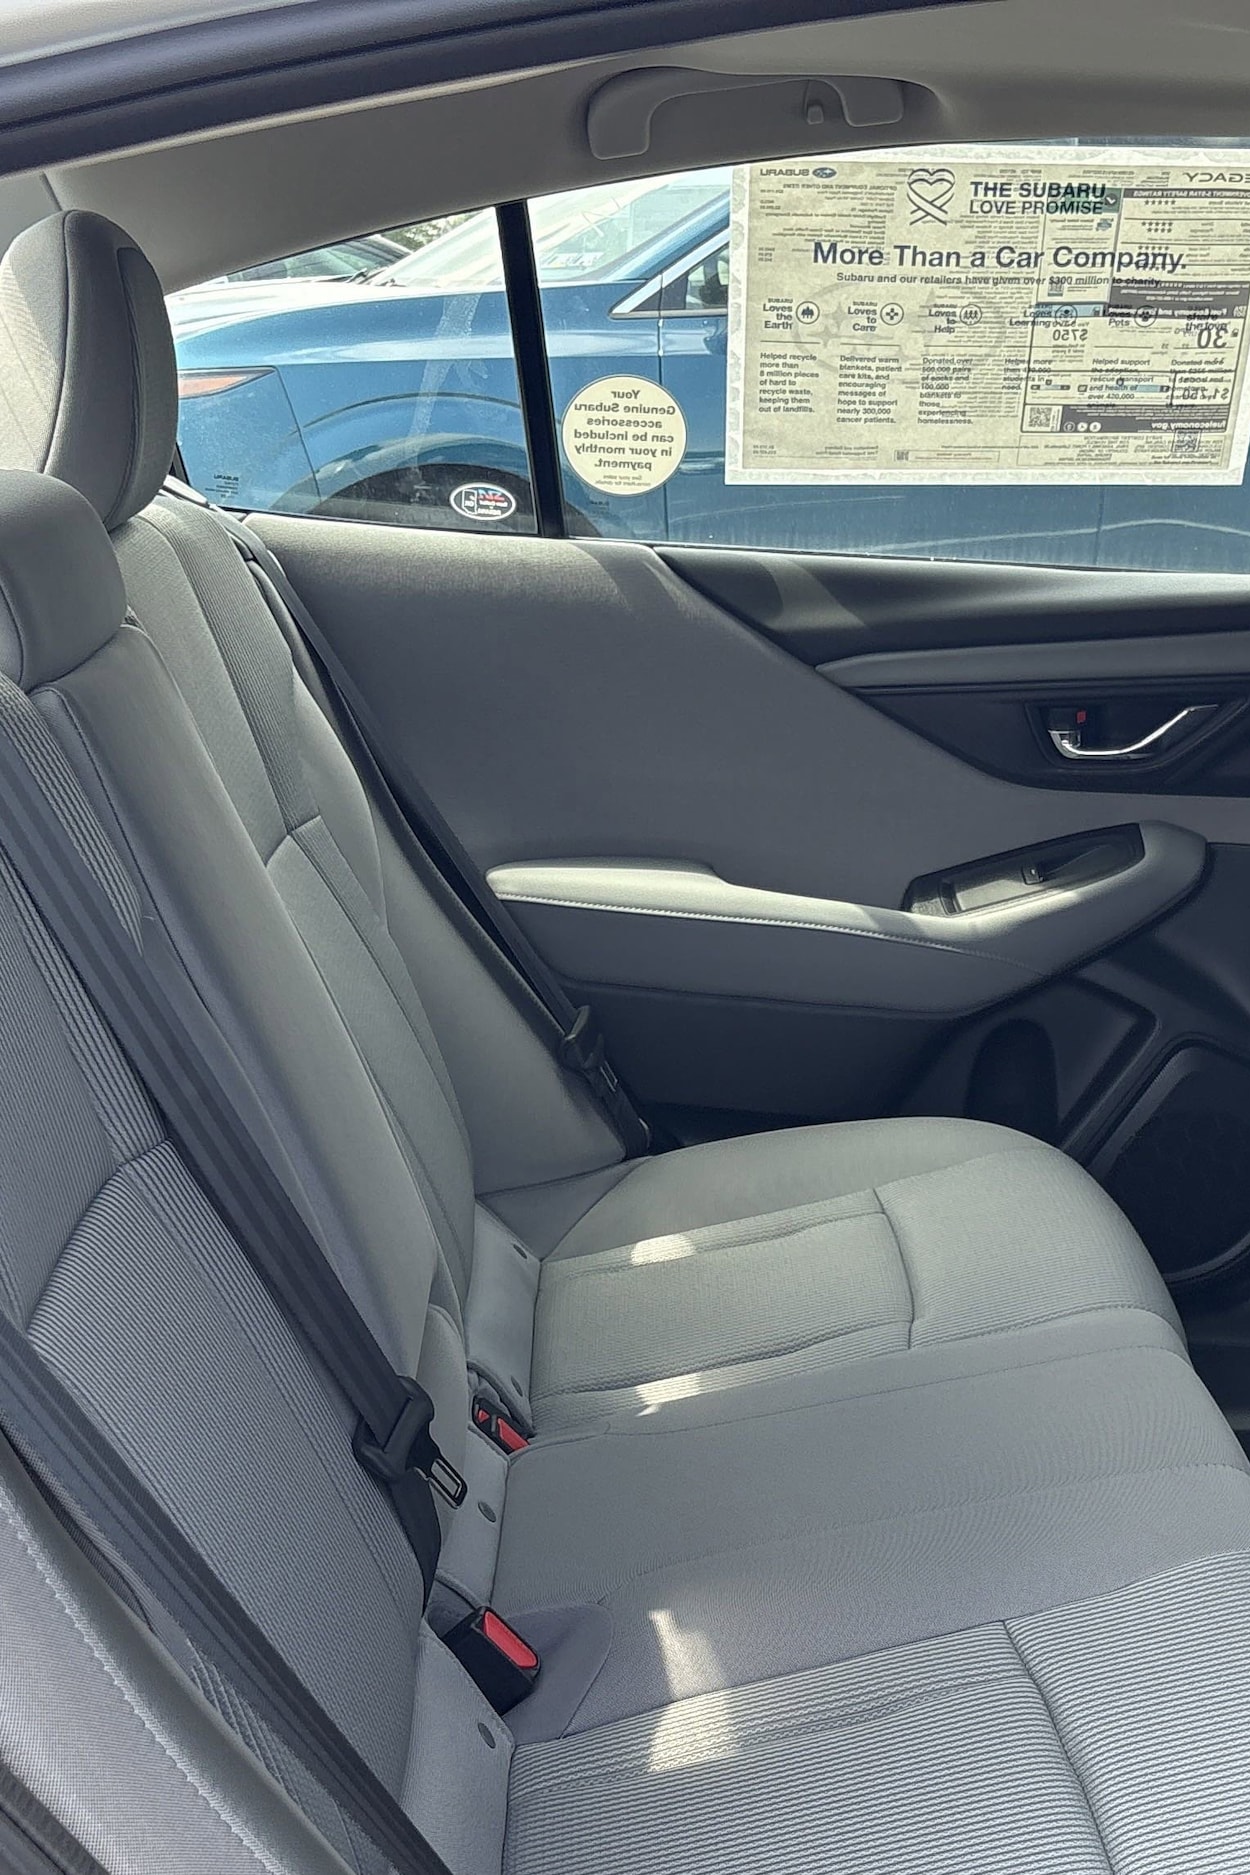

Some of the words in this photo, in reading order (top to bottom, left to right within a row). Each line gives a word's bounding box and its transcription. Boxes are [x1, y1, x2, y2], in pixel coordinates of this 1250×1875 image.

[970, 182, 1012, 198] THE
[1019, 182, 1106, 198] SUBARU
[969, 200, 1018, 214] LOVE
[1021, 201, 1103, 215] PROMISE
[813, 242, 883, 265] More
[893, 245, 961, 267] Than
[970, 252, 985, 268] a
[995, 246, 1044, 269] Car
[1053, 246, 1187, 274] Company.
[837, 272, 874, 282] Subaru
[877, 274, 897, 282] and
[921, 275, 962, 284] retailers
[965, 276, 990, 285] have
[993, 276, 1020, 286] given
[1023, 277, 1046, 285] over
[1049, 276, 1073, 286] $300
[1075, 276, 1109, 285] million
[1112, 277, 1124, 285] to
[763, 304, 793, 312] Loves
[848, 307, 877, 315] Loves
[776, 313, 793, 321] the
[928, 309, 957, 317] Loves
[867, 316, 877, 324] to
[946, 317, 956, 325] to
[1109, 318, 1130, 326] Pets
[764, 321, 793, 329] Earth
[853, 323, 877, 332] Care
[934, 325, 955, 334] Help
[840, 355, 876, 363] Delivered
[1092, 358, 1119, 366] Helped
[794, 371, 819, 379] pieces
[857, 373, 873, 381] kits,
[759, 388, 786, 396] recycle
[759, 397, 789, 405] keeping
[868, 399, 898, 407] support
[837, 408, 860, 416] nearly
